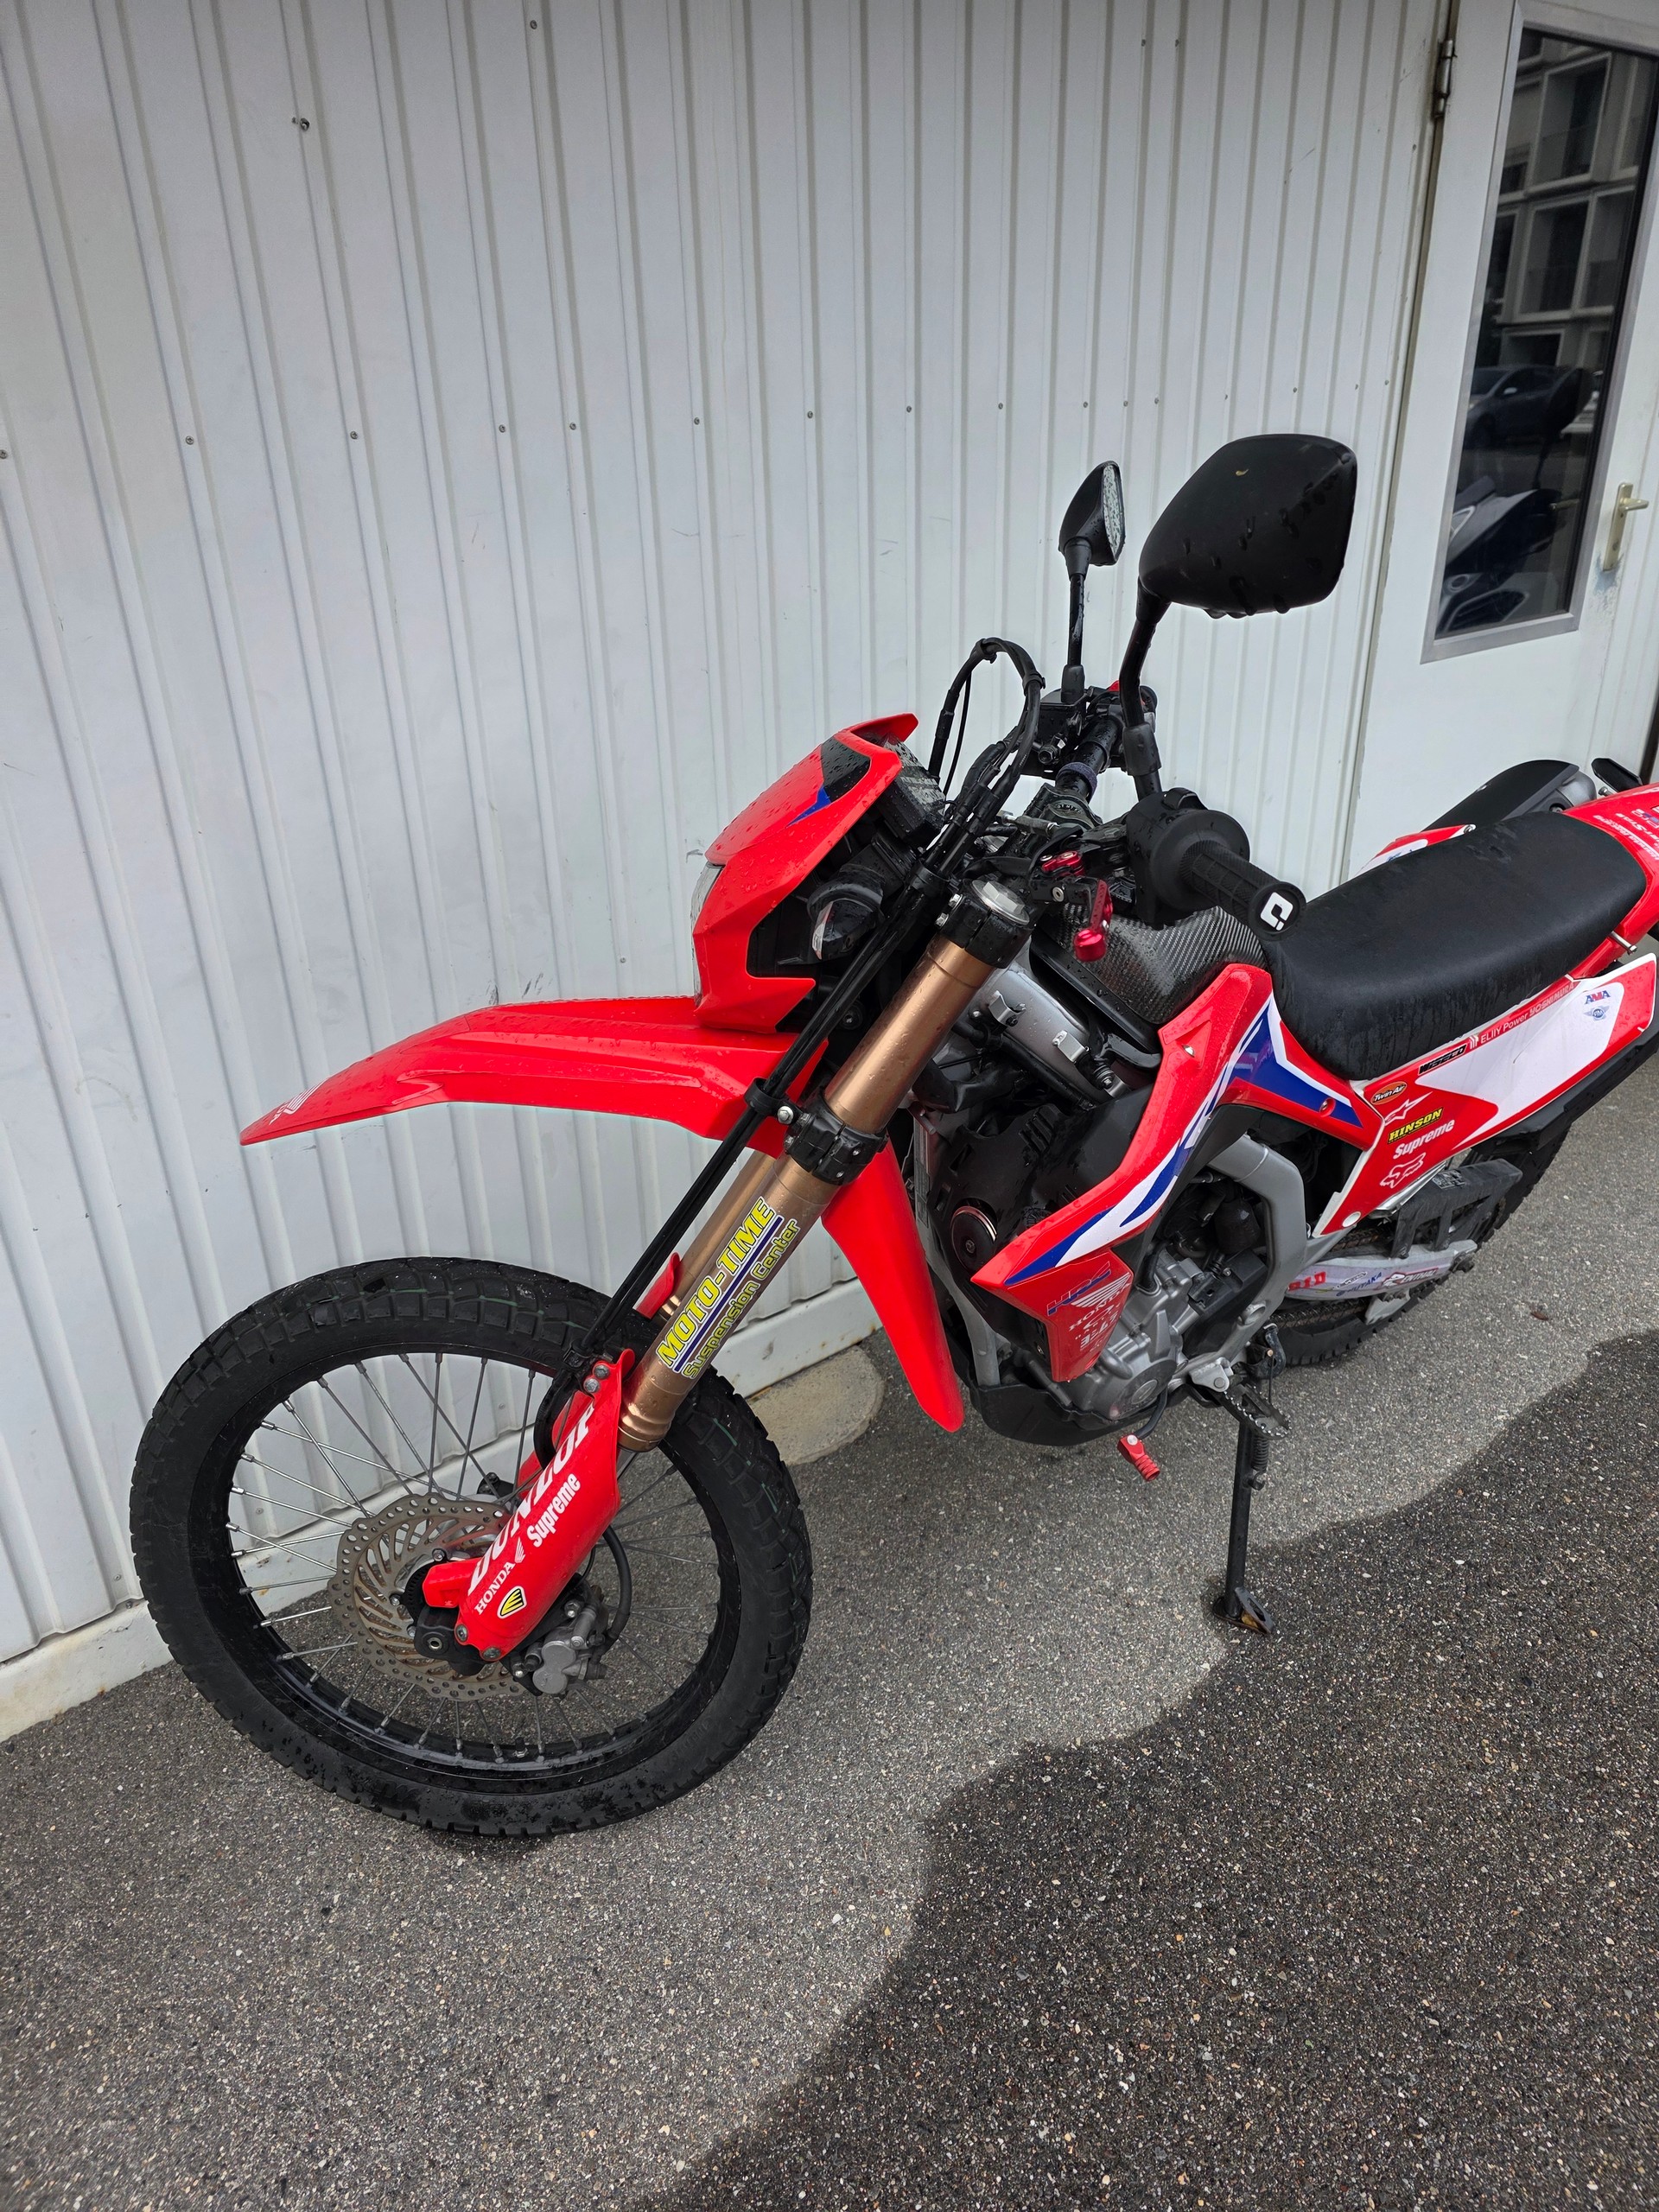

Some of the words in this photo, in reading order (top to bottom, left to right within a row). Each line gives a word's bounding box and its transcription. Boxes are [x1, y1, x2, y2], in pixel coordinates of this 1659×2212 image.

[1503, 1013, 1528, 1032] Power
[1529, 983, 1575, 1017] YOSHIMURA
[1585, 990, 1611, 1005] AMA
[1374, 1090, 1394, 1103] Twin
[1392, 1084, 1407, 1096] Air
[1389, 1108, 1443, 1141] HINSON
[1393, 1119, 1456, 1160] Supreme
[683, 1281, 760, 1380] Suspension
[752, 1218, 801, 1281] Center
[1046, 1261, 1112, 1316] HRC
[1069, 1282, 1132, 1332] HONDA
[526, 1472, 581, 1548] Supreme
[474, 1561, 516, 1616] HONDA
